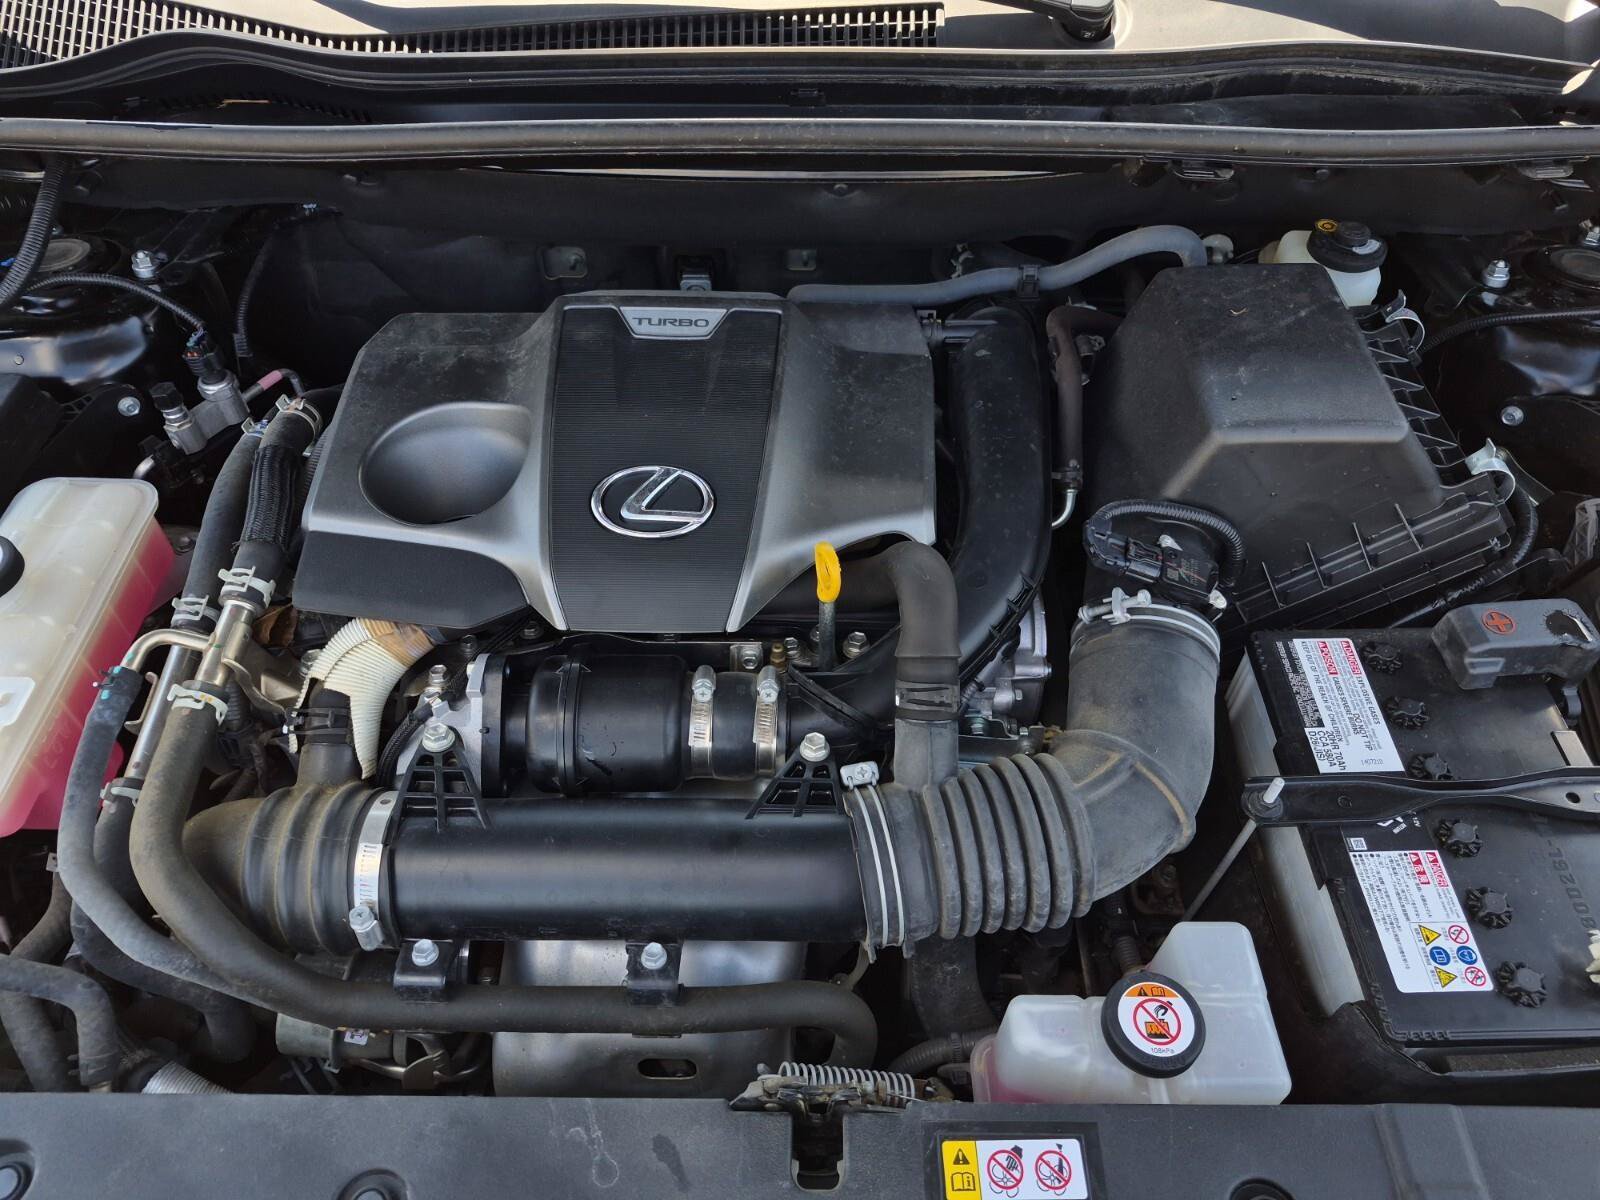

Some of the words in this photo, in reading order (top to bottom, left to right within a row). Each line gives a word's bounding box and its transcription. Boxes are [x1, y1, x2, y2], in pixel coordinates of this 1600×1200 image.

[631, 317, 710, 328] TURBO
[1301, 641, 1310, 653] KEEP
[1306, 654, 1314, 665] OUT
[1313, 674, 1322, 684] THE
[1345, 647, 1361, 674] DANGER
[1356, 676, 1372, 705] EXPLOSIVE
[1369, 707, 1380, 724] GASES
[1317, 685, 1328, 703] REACH
[1321, 648, 1337, 674] POISON
[1332, 677, 1344, 696] CAUSES
[1340, 696, 1352, 715] SEVERE
[1348, 716, 1359, 735] BURNS
[1325, 704, 1333, 712] OF
[1328, 713, 1343, 742] CHILDREN
[1352, 713, 1362, 722] DO
[1358, 724, 1368, 738] NOT
[1364, 741, 1373, 751] TIP
[1317, 730, 1329, 747] CCA
[1326, 730, 1339, 749] 20HR
[1334, 752, 1347, 770] 70Ah
[1431, 863, 1448, 887] DANGER
